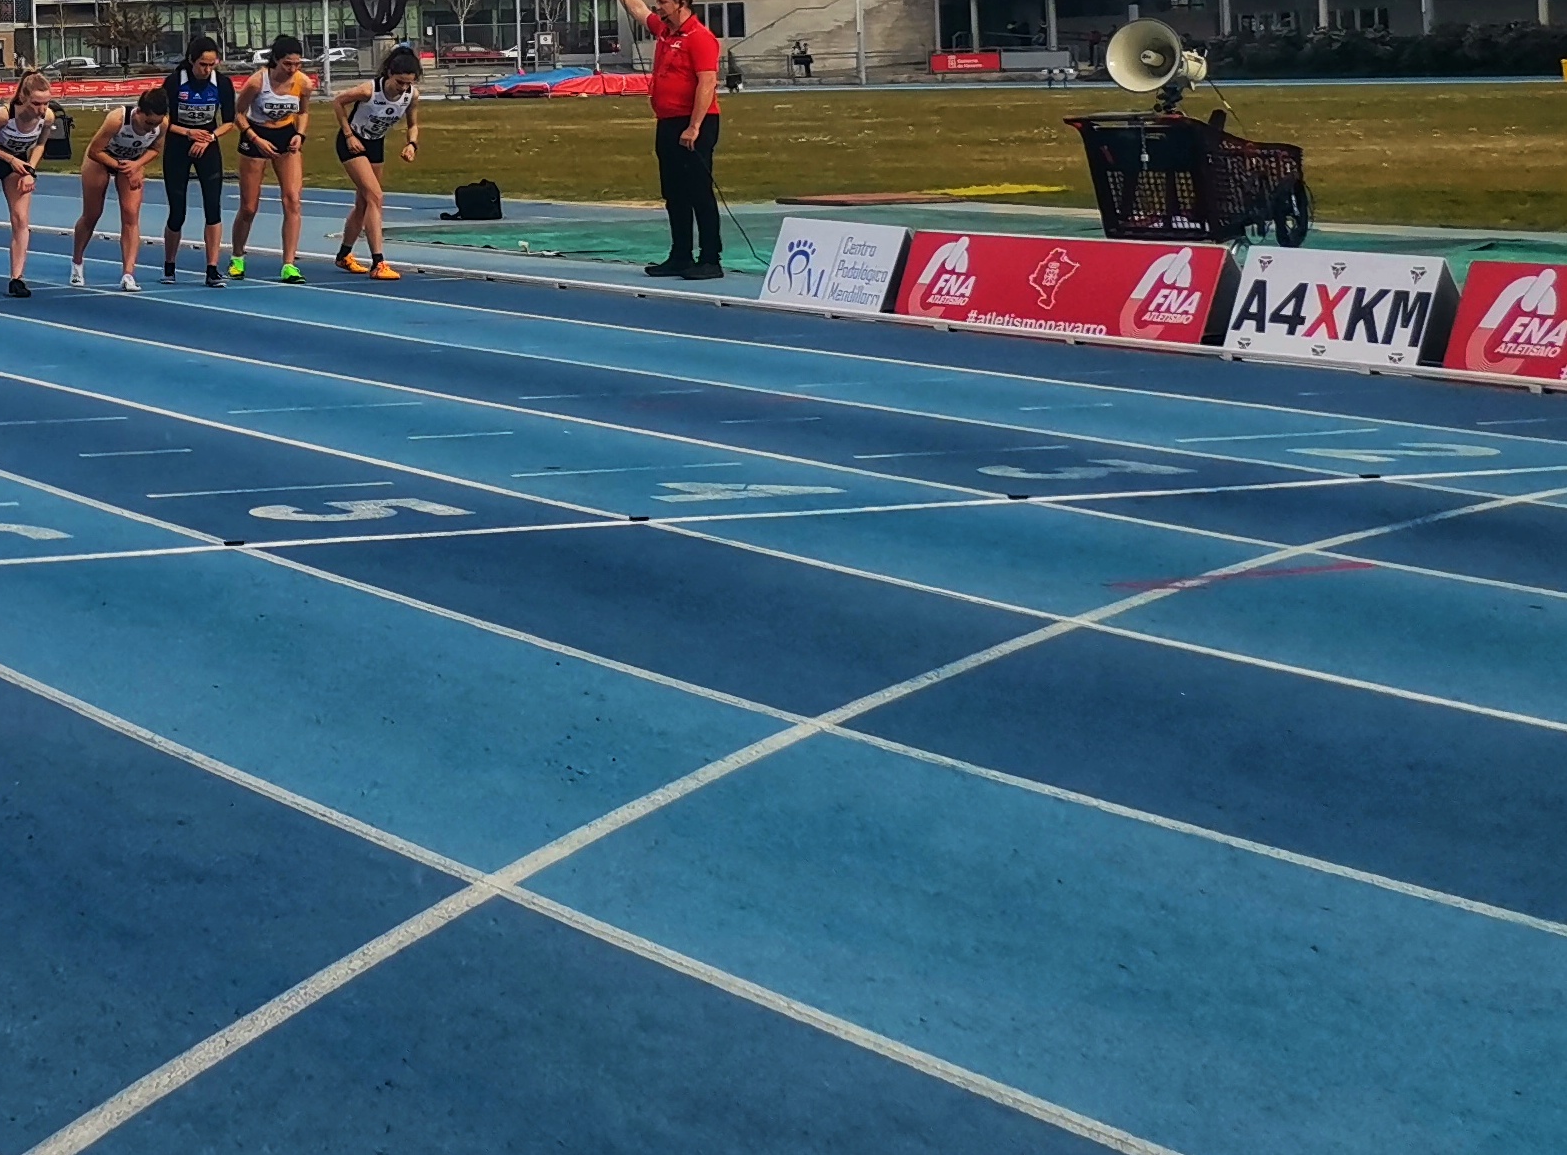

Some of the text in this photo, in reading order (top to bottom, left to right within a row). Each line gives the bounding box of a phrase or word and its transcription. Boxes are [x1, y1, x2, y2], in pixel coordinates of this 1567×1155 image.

[842, 236, 877, 257] Centro
[836, 259, 888, 285] Podológico
[932, 273, 977, 298] FNA
[925, 294, 970, 307] ATLETISMO
[1148, 288, 1202, 314] FNA
[1230, 278, 1433, 348] A4XKM
[966, 309, 1107, 336] #atletismonavarro
[1141, 311, 1195, 325] ATLETISMO
[1502, 316, 1567, 347] FNA
[1493, 342, 1562, 358] ATLETISMO
[247, 497, 477, 524] 5
